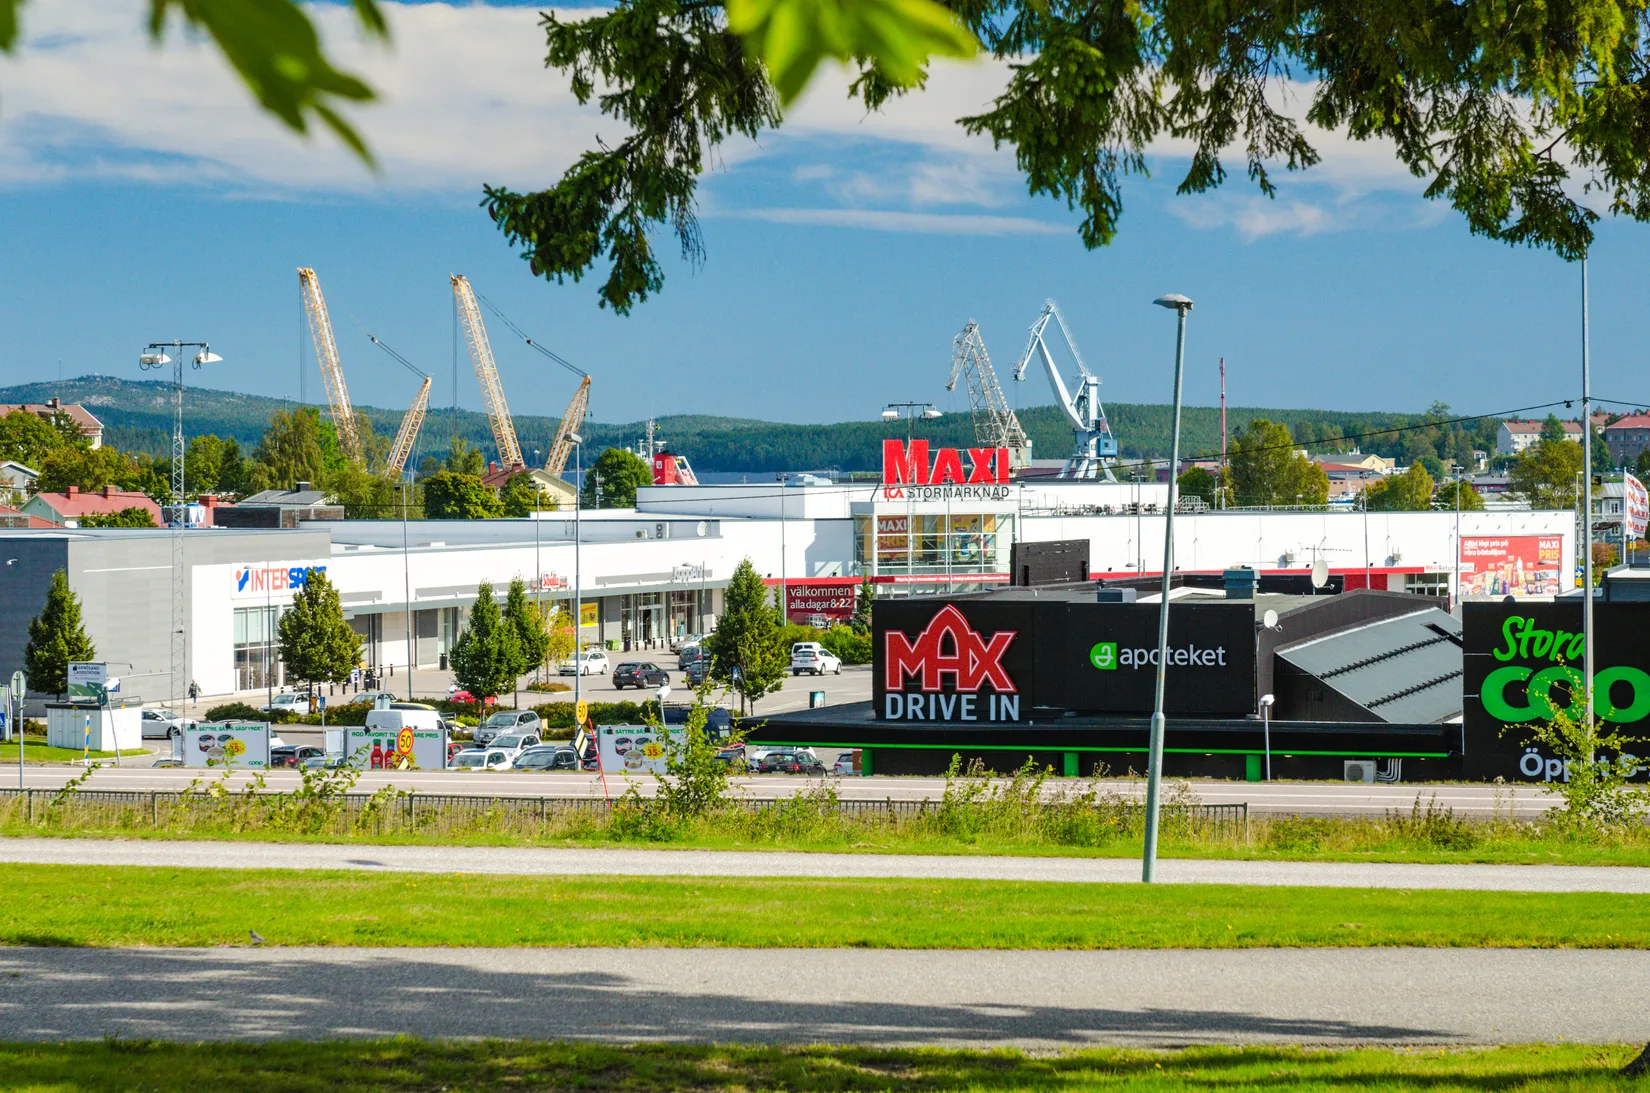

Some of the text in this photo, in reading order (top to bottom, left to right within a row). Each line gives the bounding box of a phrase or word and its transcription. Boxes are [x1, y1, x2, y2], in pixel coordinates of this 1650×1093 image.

[883, 439, 1010, 484] MAXI
[884, 486, 1009, 498] ICA STORMARKNAD
[877, 519, 907, 531] MAXI
[1539, 541, 1559, 549] MAXI
[1539, 550, 1559, 559] PRIS
[790, 586, 851, 596] välkommen
[790, 598, 850, 611] alla dagar 8-22
[1493, 615, 1585, 661] Stora
[884, 604, 1018, 692] MAX
[1119, 645, 1226, 670] apoteket
[579, 705, 585, 718] 50
[885, 694, 1019, 721] DRIVE IN
[400, 735, 412, 748] 50
